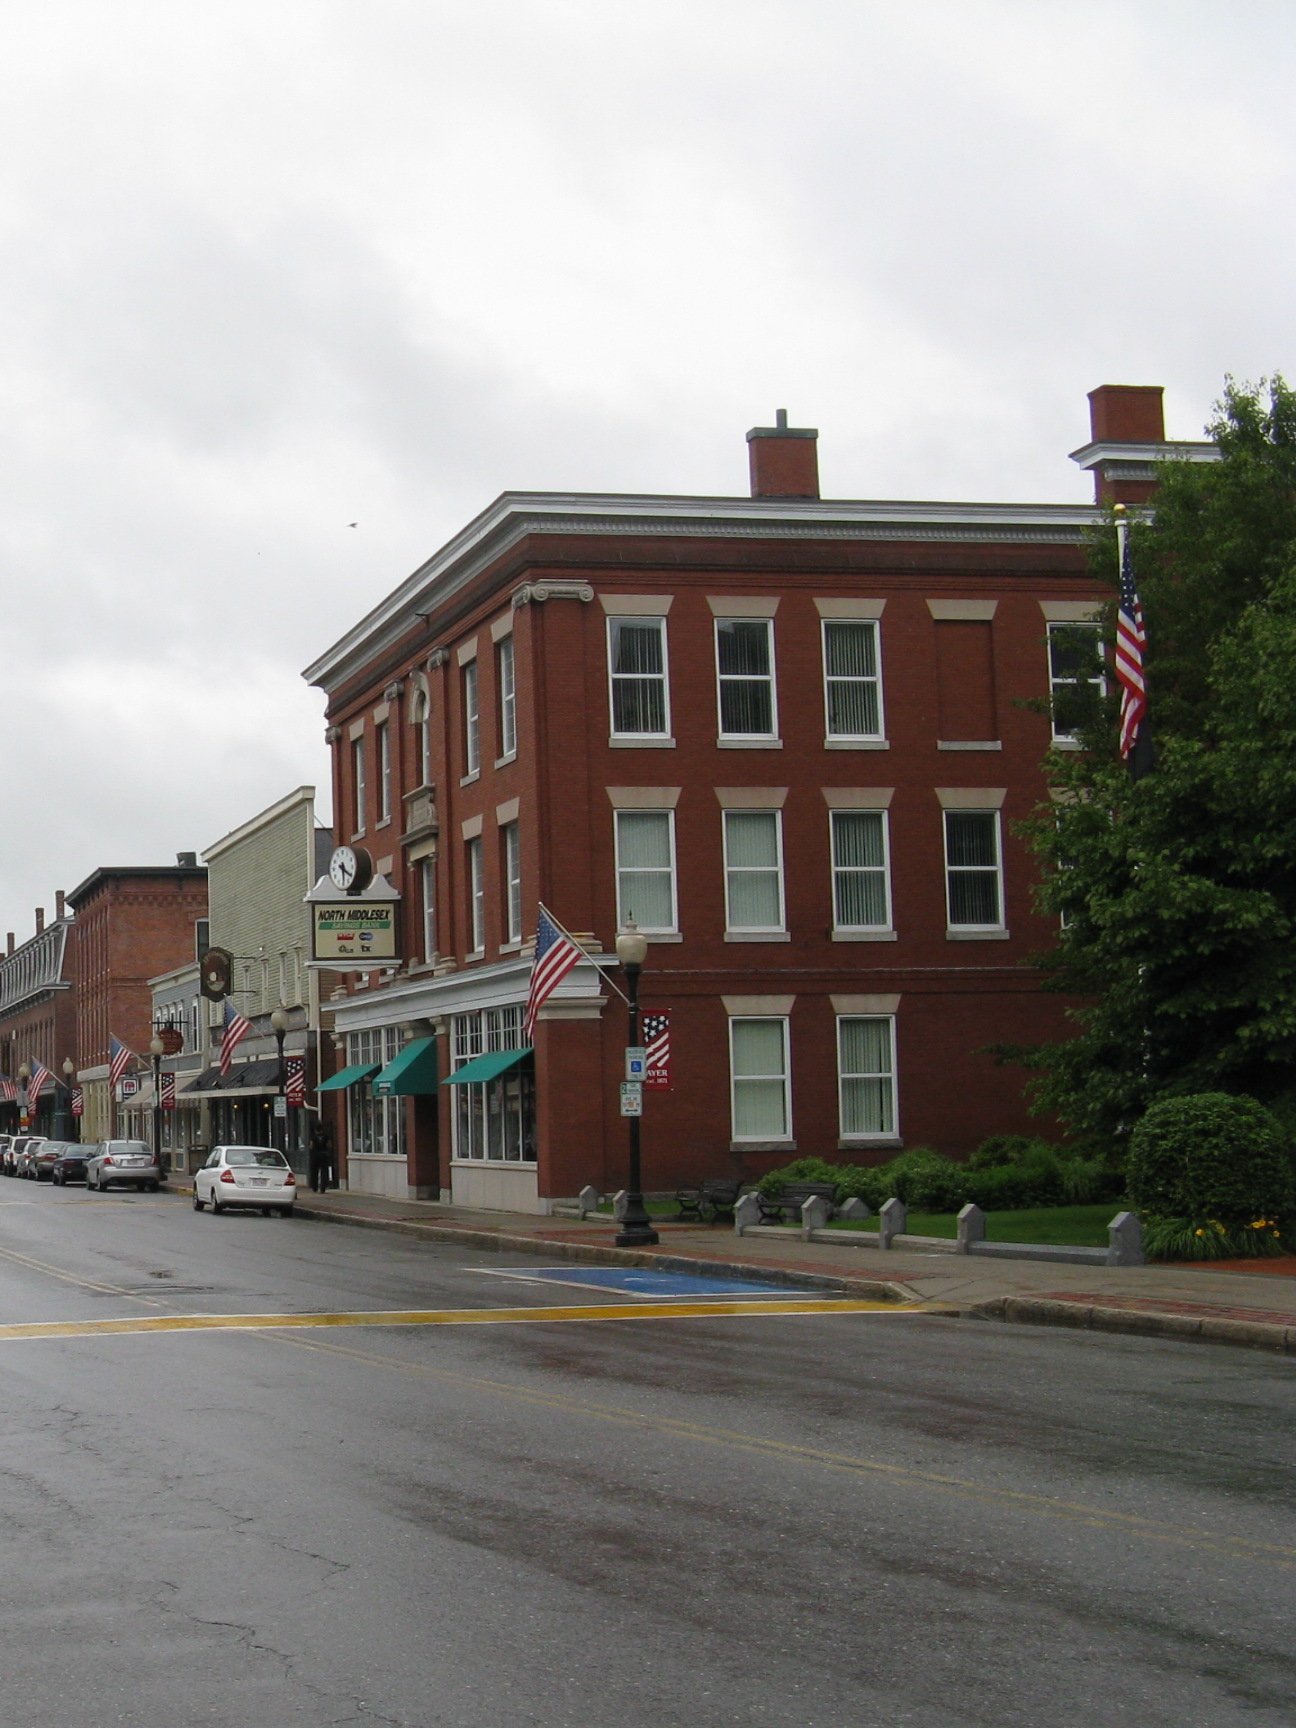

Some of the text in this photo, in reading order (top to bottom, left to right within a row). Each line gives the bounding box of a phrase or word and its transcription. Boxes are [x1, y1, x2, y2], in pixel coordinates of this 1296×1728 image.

[318, 909, 390, 921] NORTH MIDDLESEX
[361, 921, 380, 929] BANK
